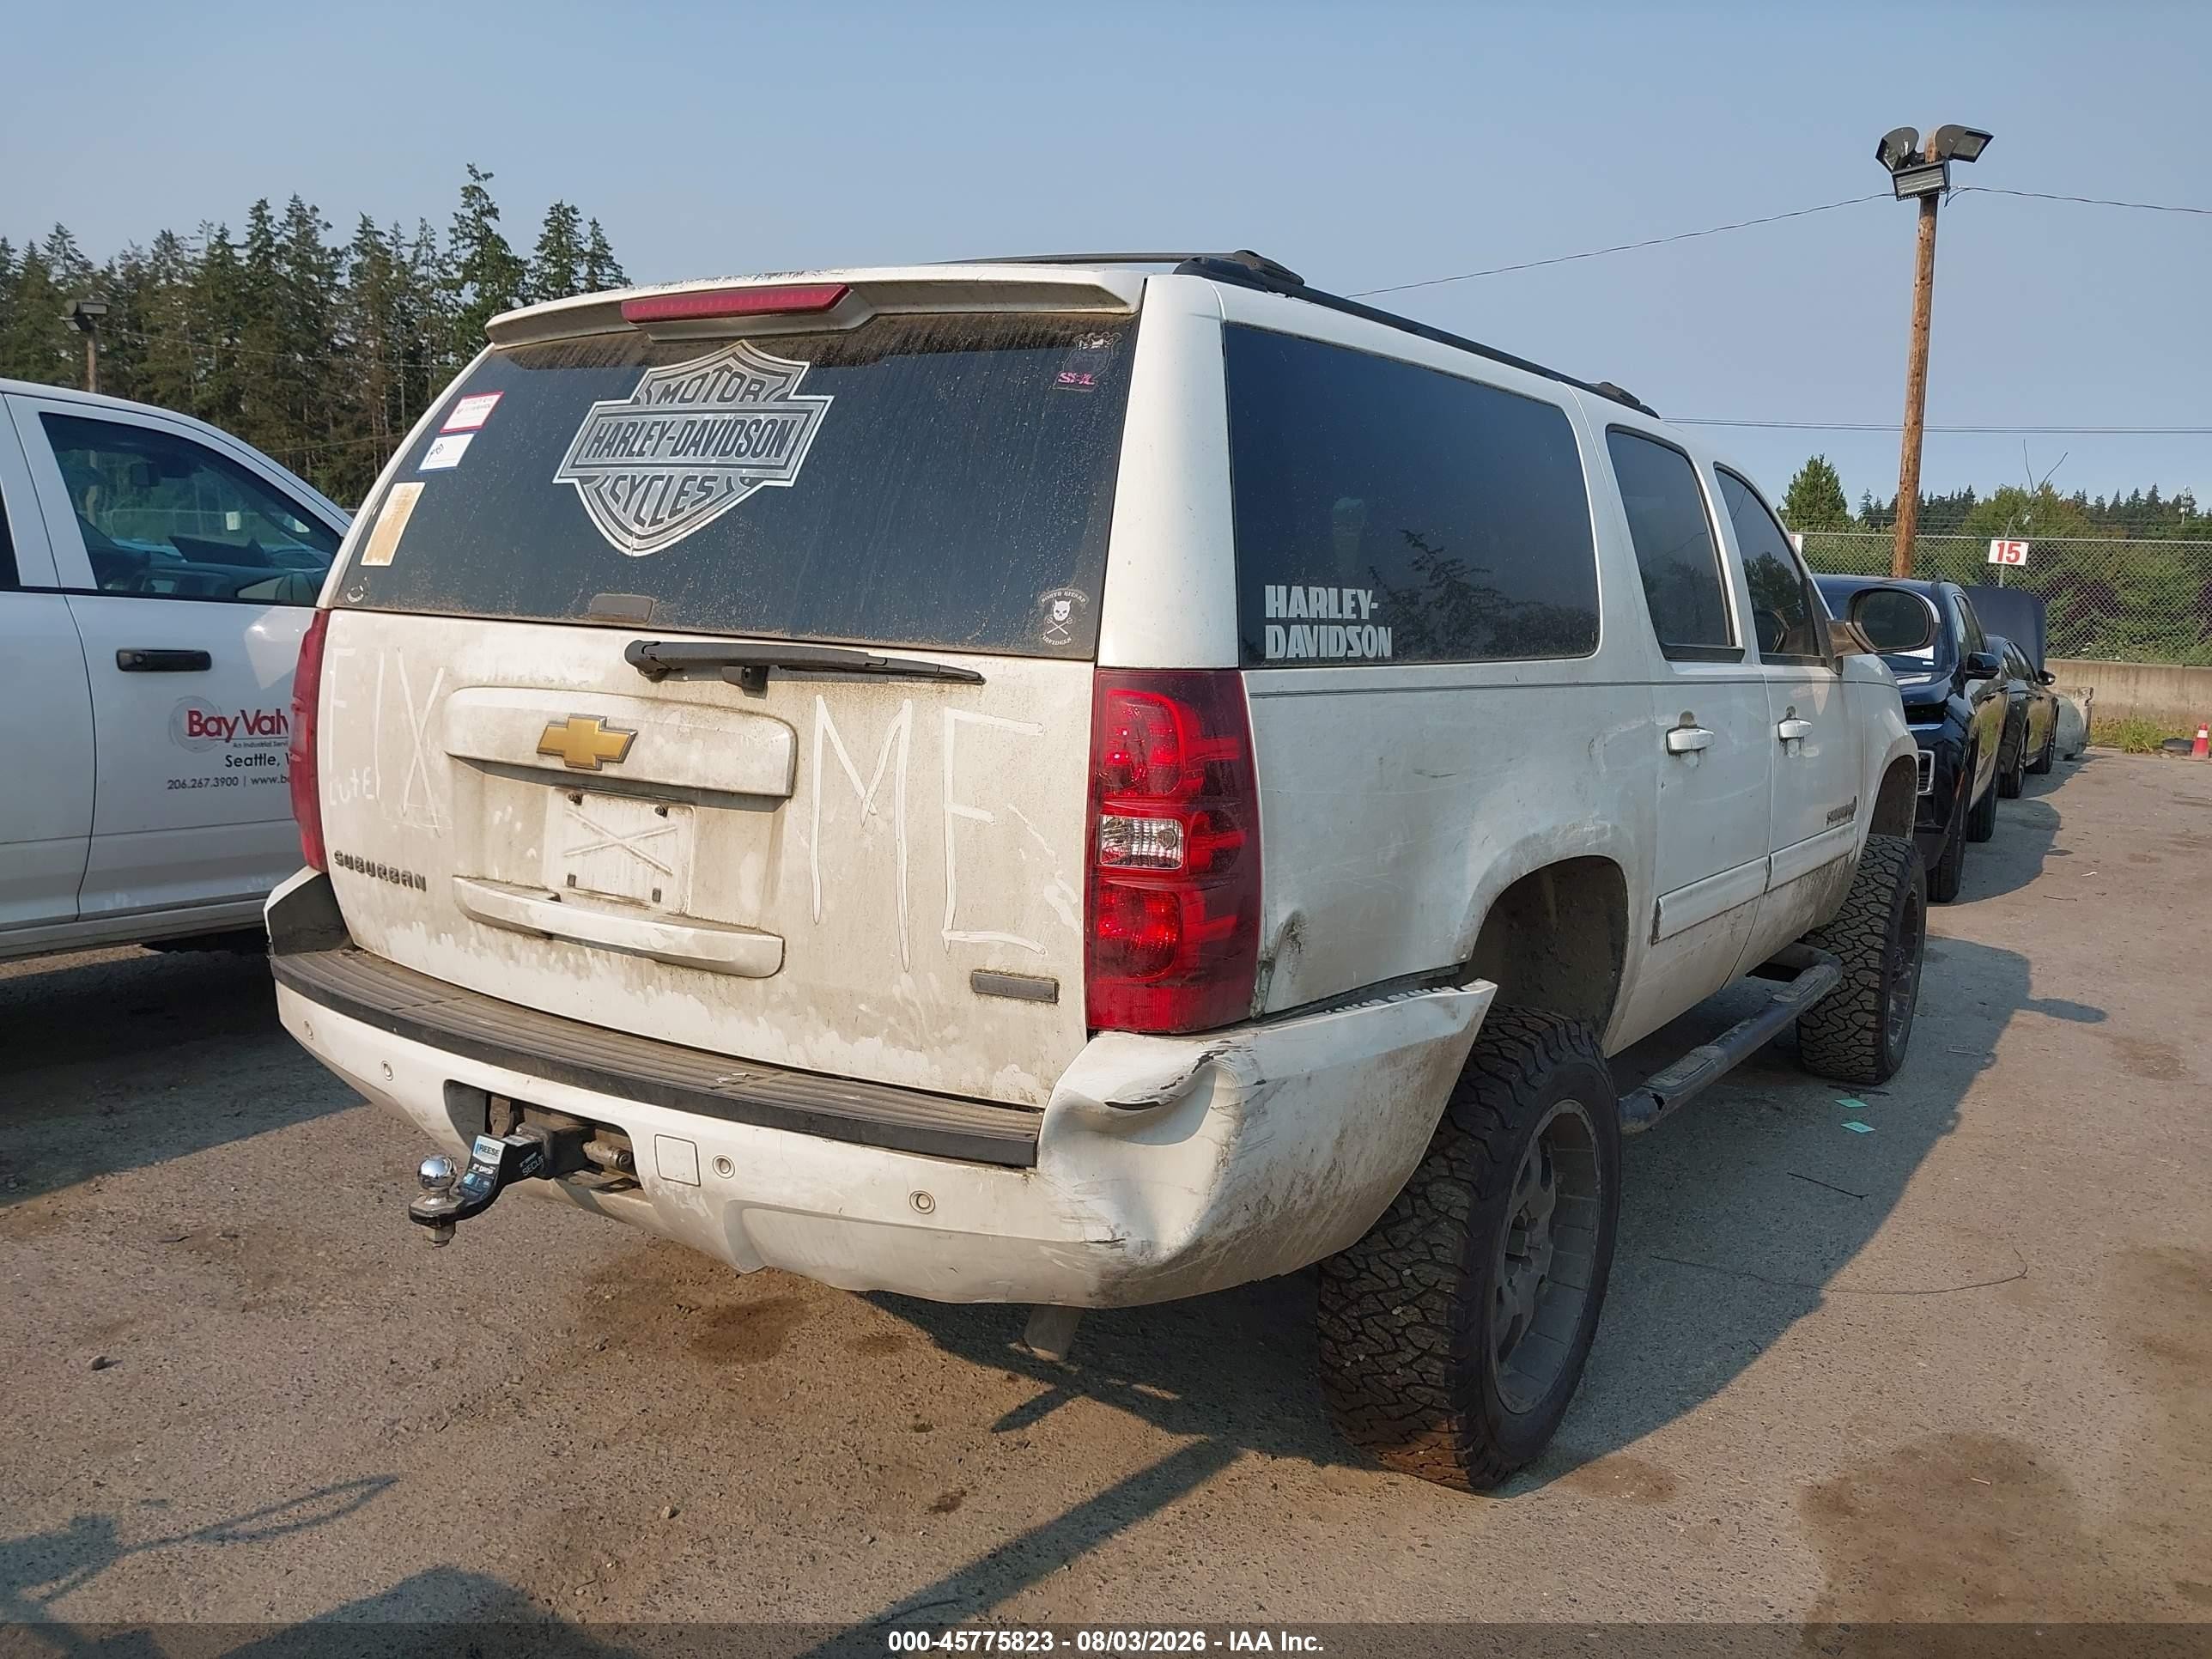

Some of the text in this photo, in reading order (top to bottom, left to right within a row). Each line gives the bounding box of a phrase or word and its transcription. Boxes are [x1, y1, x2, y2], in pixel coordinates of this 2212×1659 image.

[654, 363, 767, 405] MOTOR
[584, 418, 798, 459] HARLEY-DAVIDSON
[609, 474, 719, 528] CYCLES
[1996, 542, 2021, 563] 15
[1265, 585, 1378, 619] HARLEY-
[1265, 624, 1392, 659] DAVIDSON
[187, 709, 240, 744] Bay
[224, 752, 280, 768] Seattle,
[167, 776, 240, 790] 206.267.3900
[328, 647, 1047, 973] FIX ME
[333, 849, 427, 892] SUBURBAN
[479, 1144, 501, 1158] REESE
